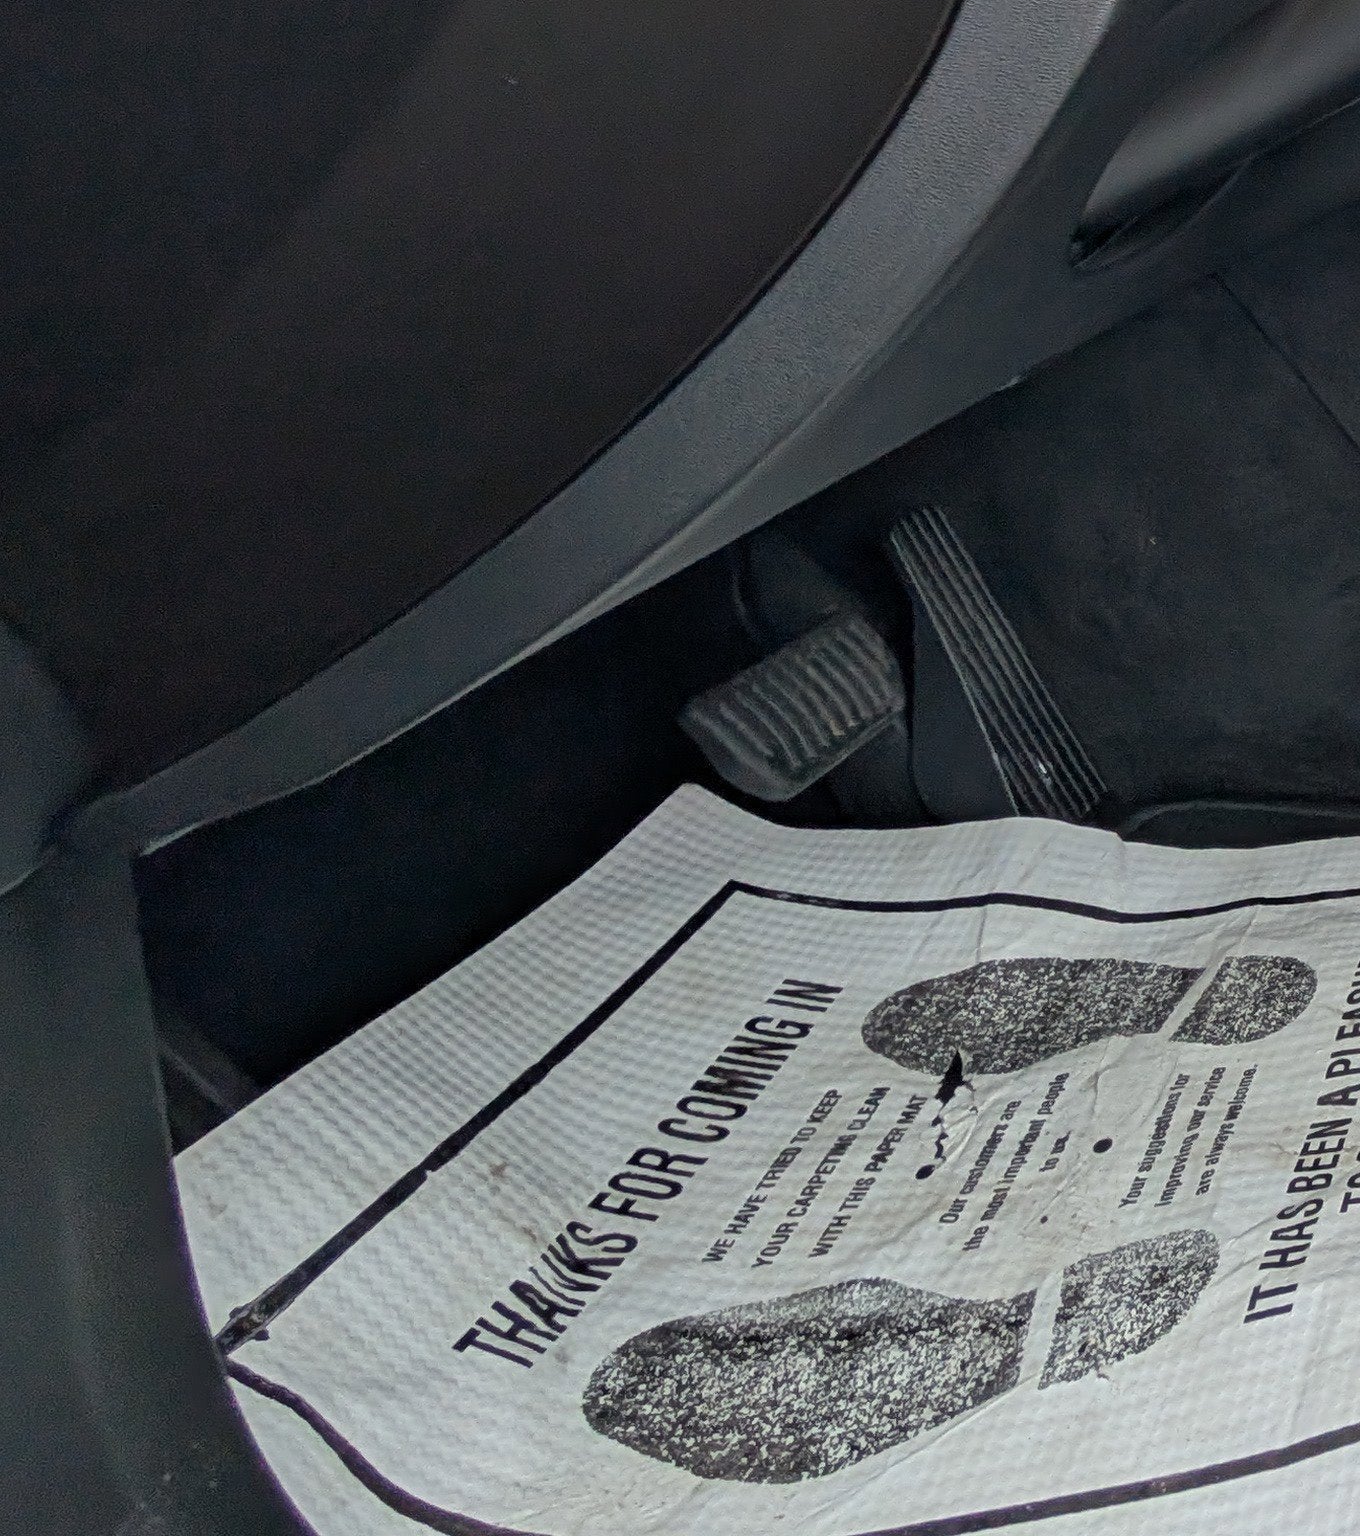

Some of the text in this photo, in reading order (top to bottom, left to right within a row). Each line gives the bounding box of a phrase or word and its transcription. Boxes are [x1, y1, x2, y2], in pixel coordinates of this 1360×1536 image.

[1118, 1073, 1190, 1208] Your suggestions for
[1187, 1109, 1206, 1132] our
[1197, 1067, 1226, 1106] service
[1195, 1168, 1215, 1196] are
[1205, 1122, 1234, 1166] always
[1286, 1117, 1352, 1193] BEEN
[452, 979, 843, 1368] THANKS FOR COMING IN
[702, 1089, 842, 1263] WE HAVE TRIED TO KEEP
[751, 1087, 890, 1268] YOUR CARPETING CLEAN
[808, 1094, 927, 1258] WITH THIS PAPER MAT
[939, 1100, 1021, 1223] Our customers are
[962, 1073, 1070, 1251] the most important people
[1039, 1157, 1059, 1172] to
[1259, 1198, 1324, 1270] HAS
[1243, 1282, 1298, 1323] IT
